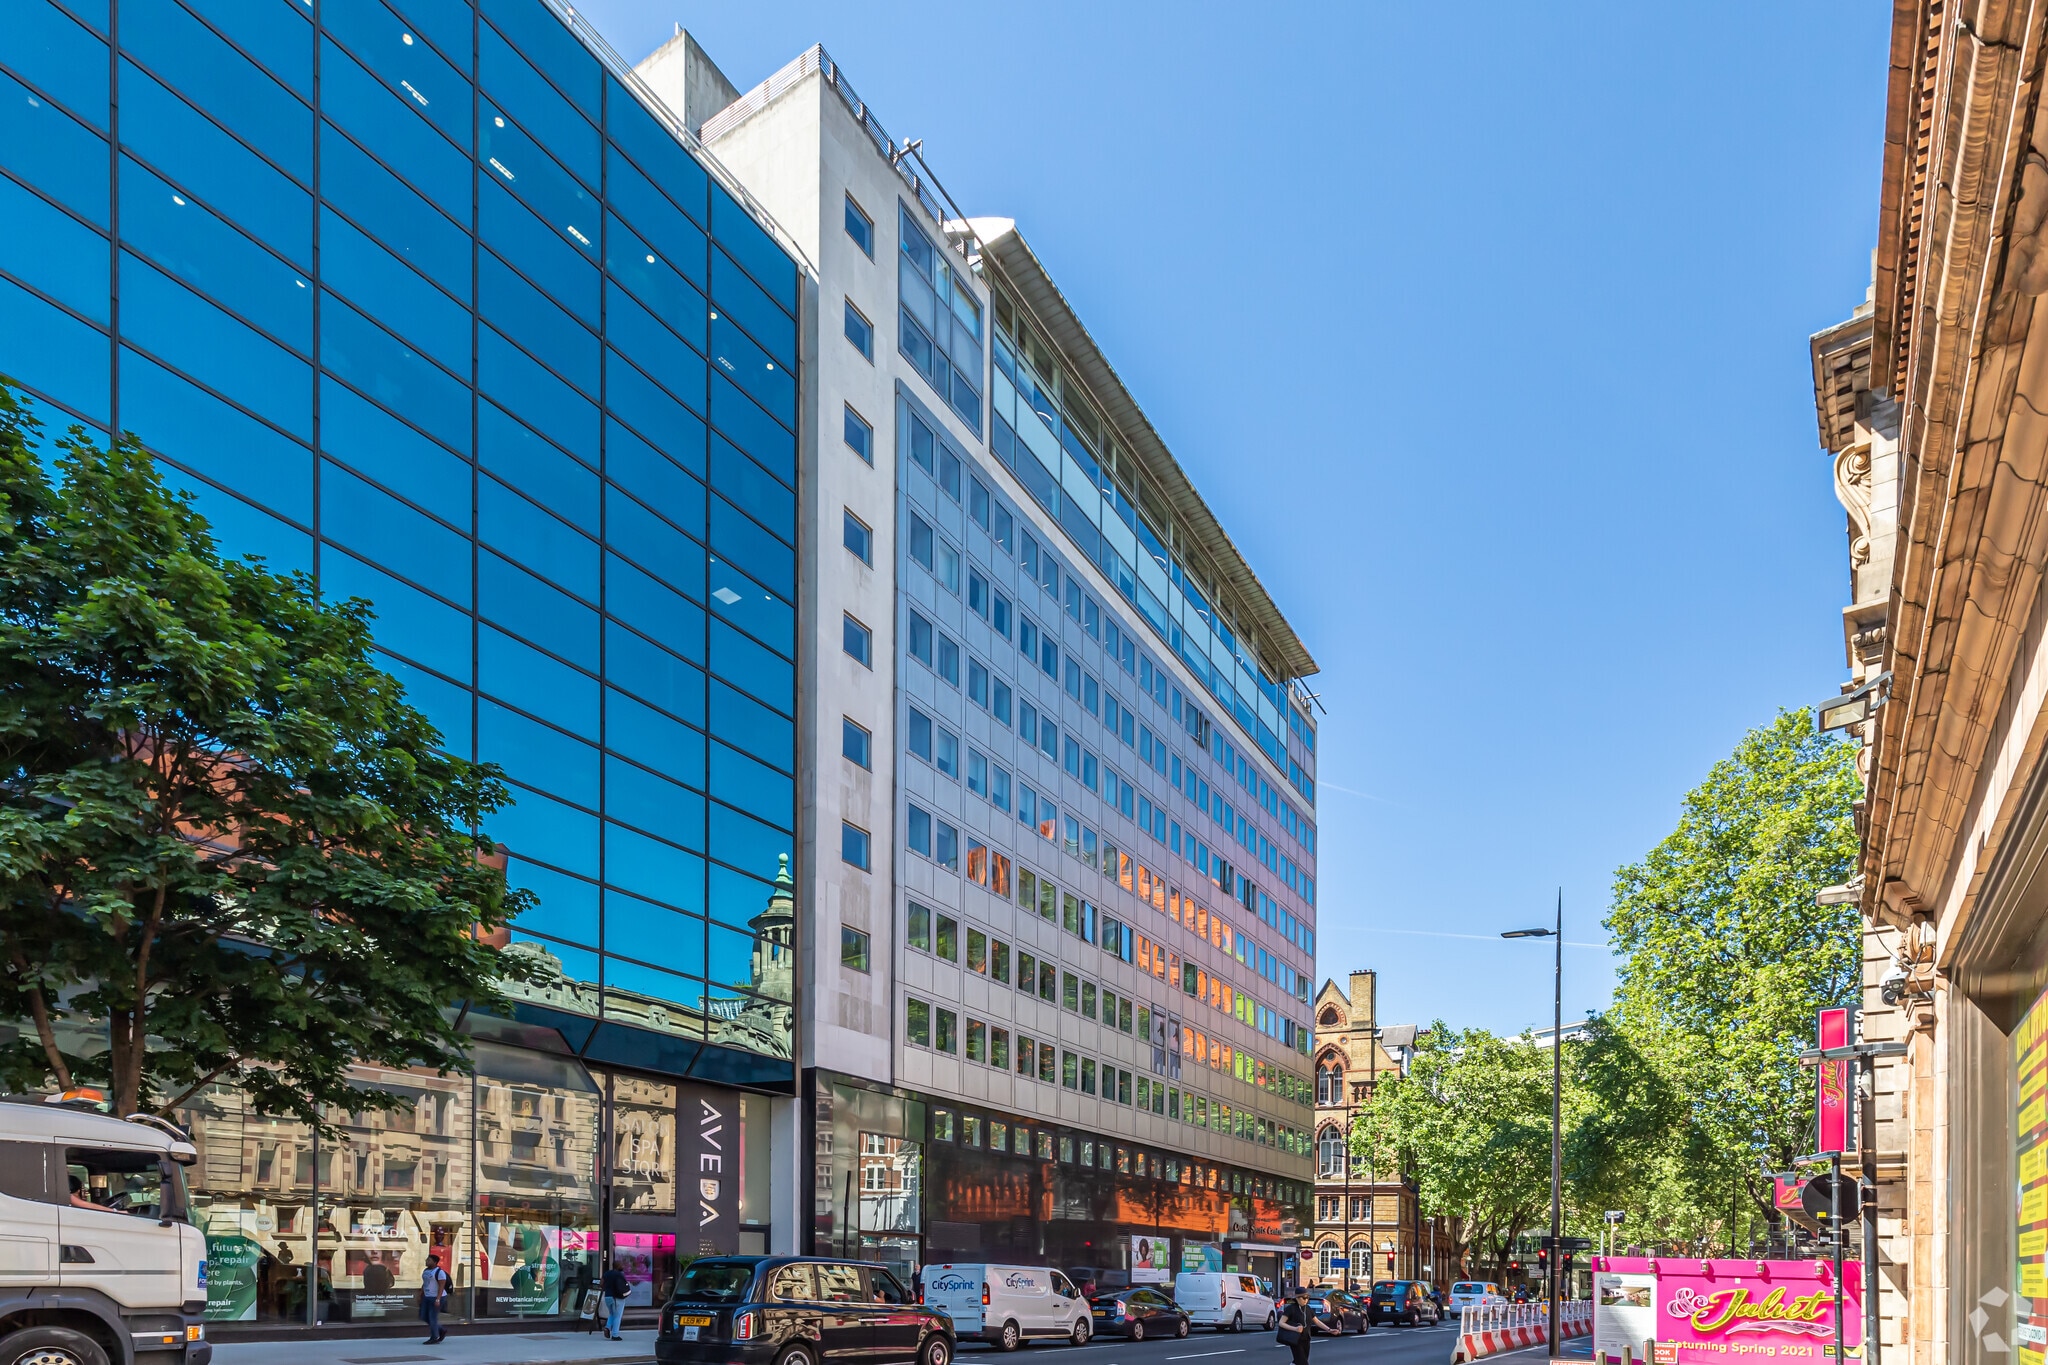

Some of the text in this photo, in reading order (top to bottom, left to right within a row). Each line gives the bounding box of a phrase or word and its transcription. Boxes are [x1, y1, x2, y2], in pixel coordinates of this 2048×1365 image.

[620, 1118, 669, 1137] SALON
[632, 1139, 660, 1156] SPA
[622, 1158, 665, 1178] STORE
[700, 1098, 722, 1227] AVEDA
[212, 1243, 243, 1252] future
[220, 1255, 250, 1265] repair
[932, 1280, 975, 1292] CitySprint
[1005, 1278, 1035, 1289] CitySprint
[1667, 1287, 1709, 1318] &
[1691, 1286, 1849, 1332] Juliet
[1731, 1342, 1776, 1357] Spring
[1781, 1343, 1813, 1357] 2021
